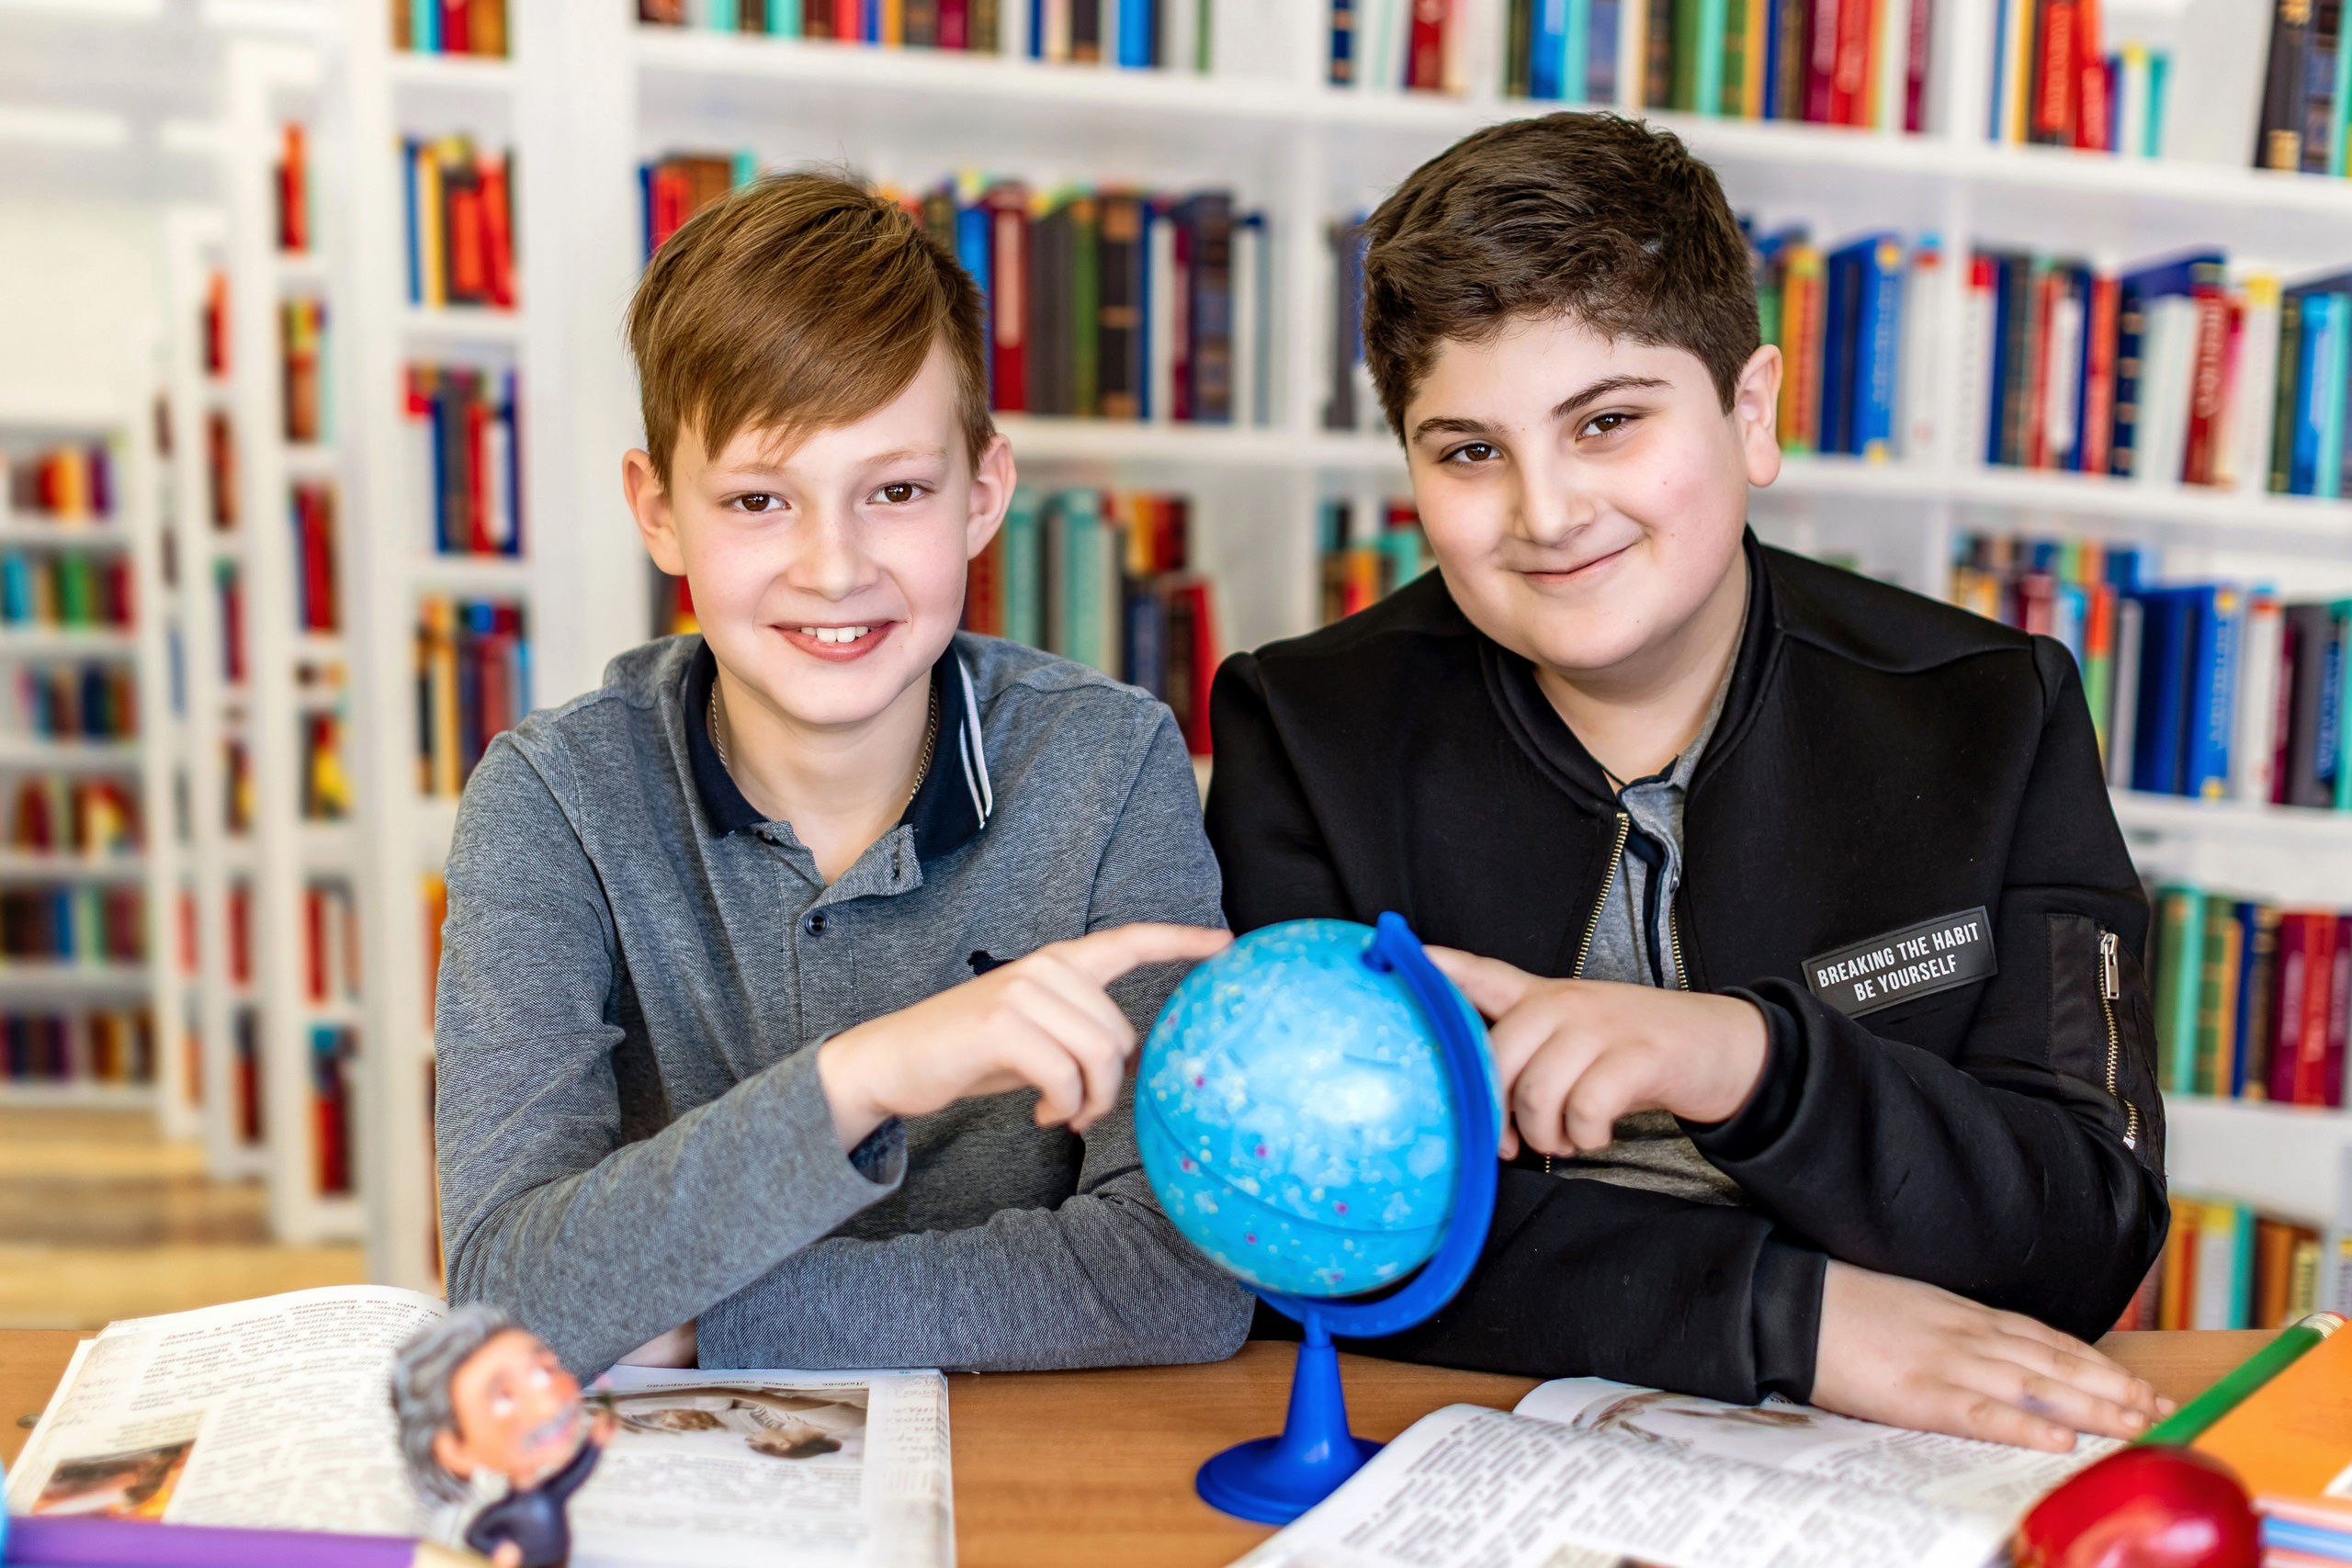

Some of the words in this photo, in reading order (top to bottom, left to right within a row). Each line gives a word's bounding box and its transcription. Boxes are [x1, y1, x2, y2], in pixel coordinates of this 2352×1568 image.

[1816, 947, 1895, 988] BREAKING
[1896, 936, 1930, 961] THE
[1931, 922, 1979, 952] HABIT
[1853, 979, 1876, 1002] BE
[1877, 953, 1957, 993] YOURSELF
